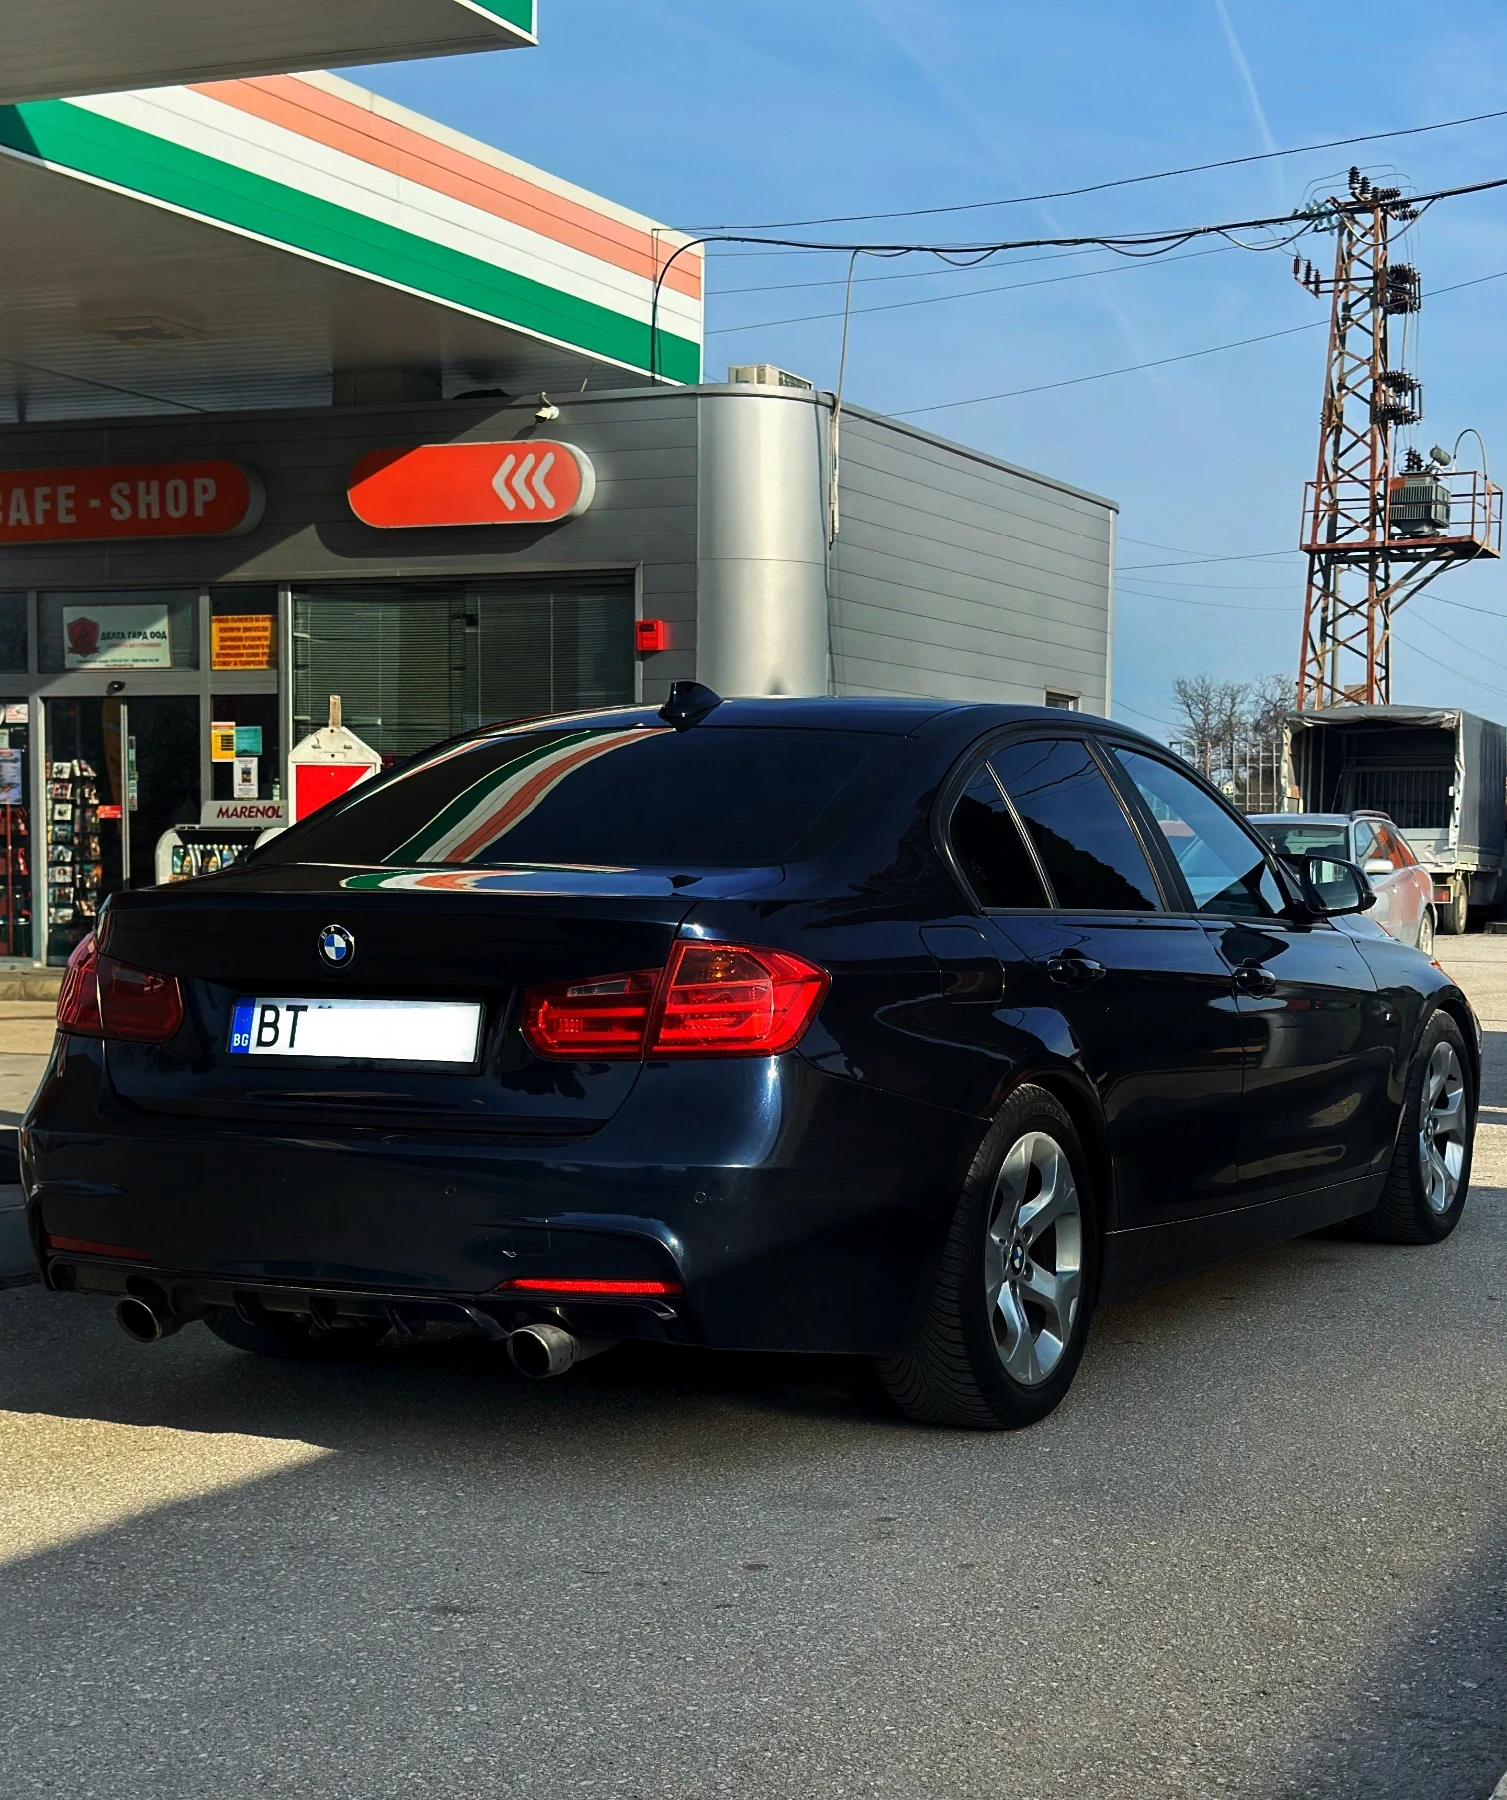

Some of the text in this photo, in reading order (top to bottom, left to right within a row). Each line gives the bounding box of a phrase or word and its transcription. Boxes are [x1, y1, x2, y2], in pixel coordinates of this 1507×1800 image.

[0, 484, 77, 526] AFE
[109, 477, 217, 522] SHOP
[127, 631, 148, 640] ГАРД
[149, 630, 167, 640] ООД
[216, 805, 283, 819] MARENOL
[233, 1004, 308, 1048] BG BT
